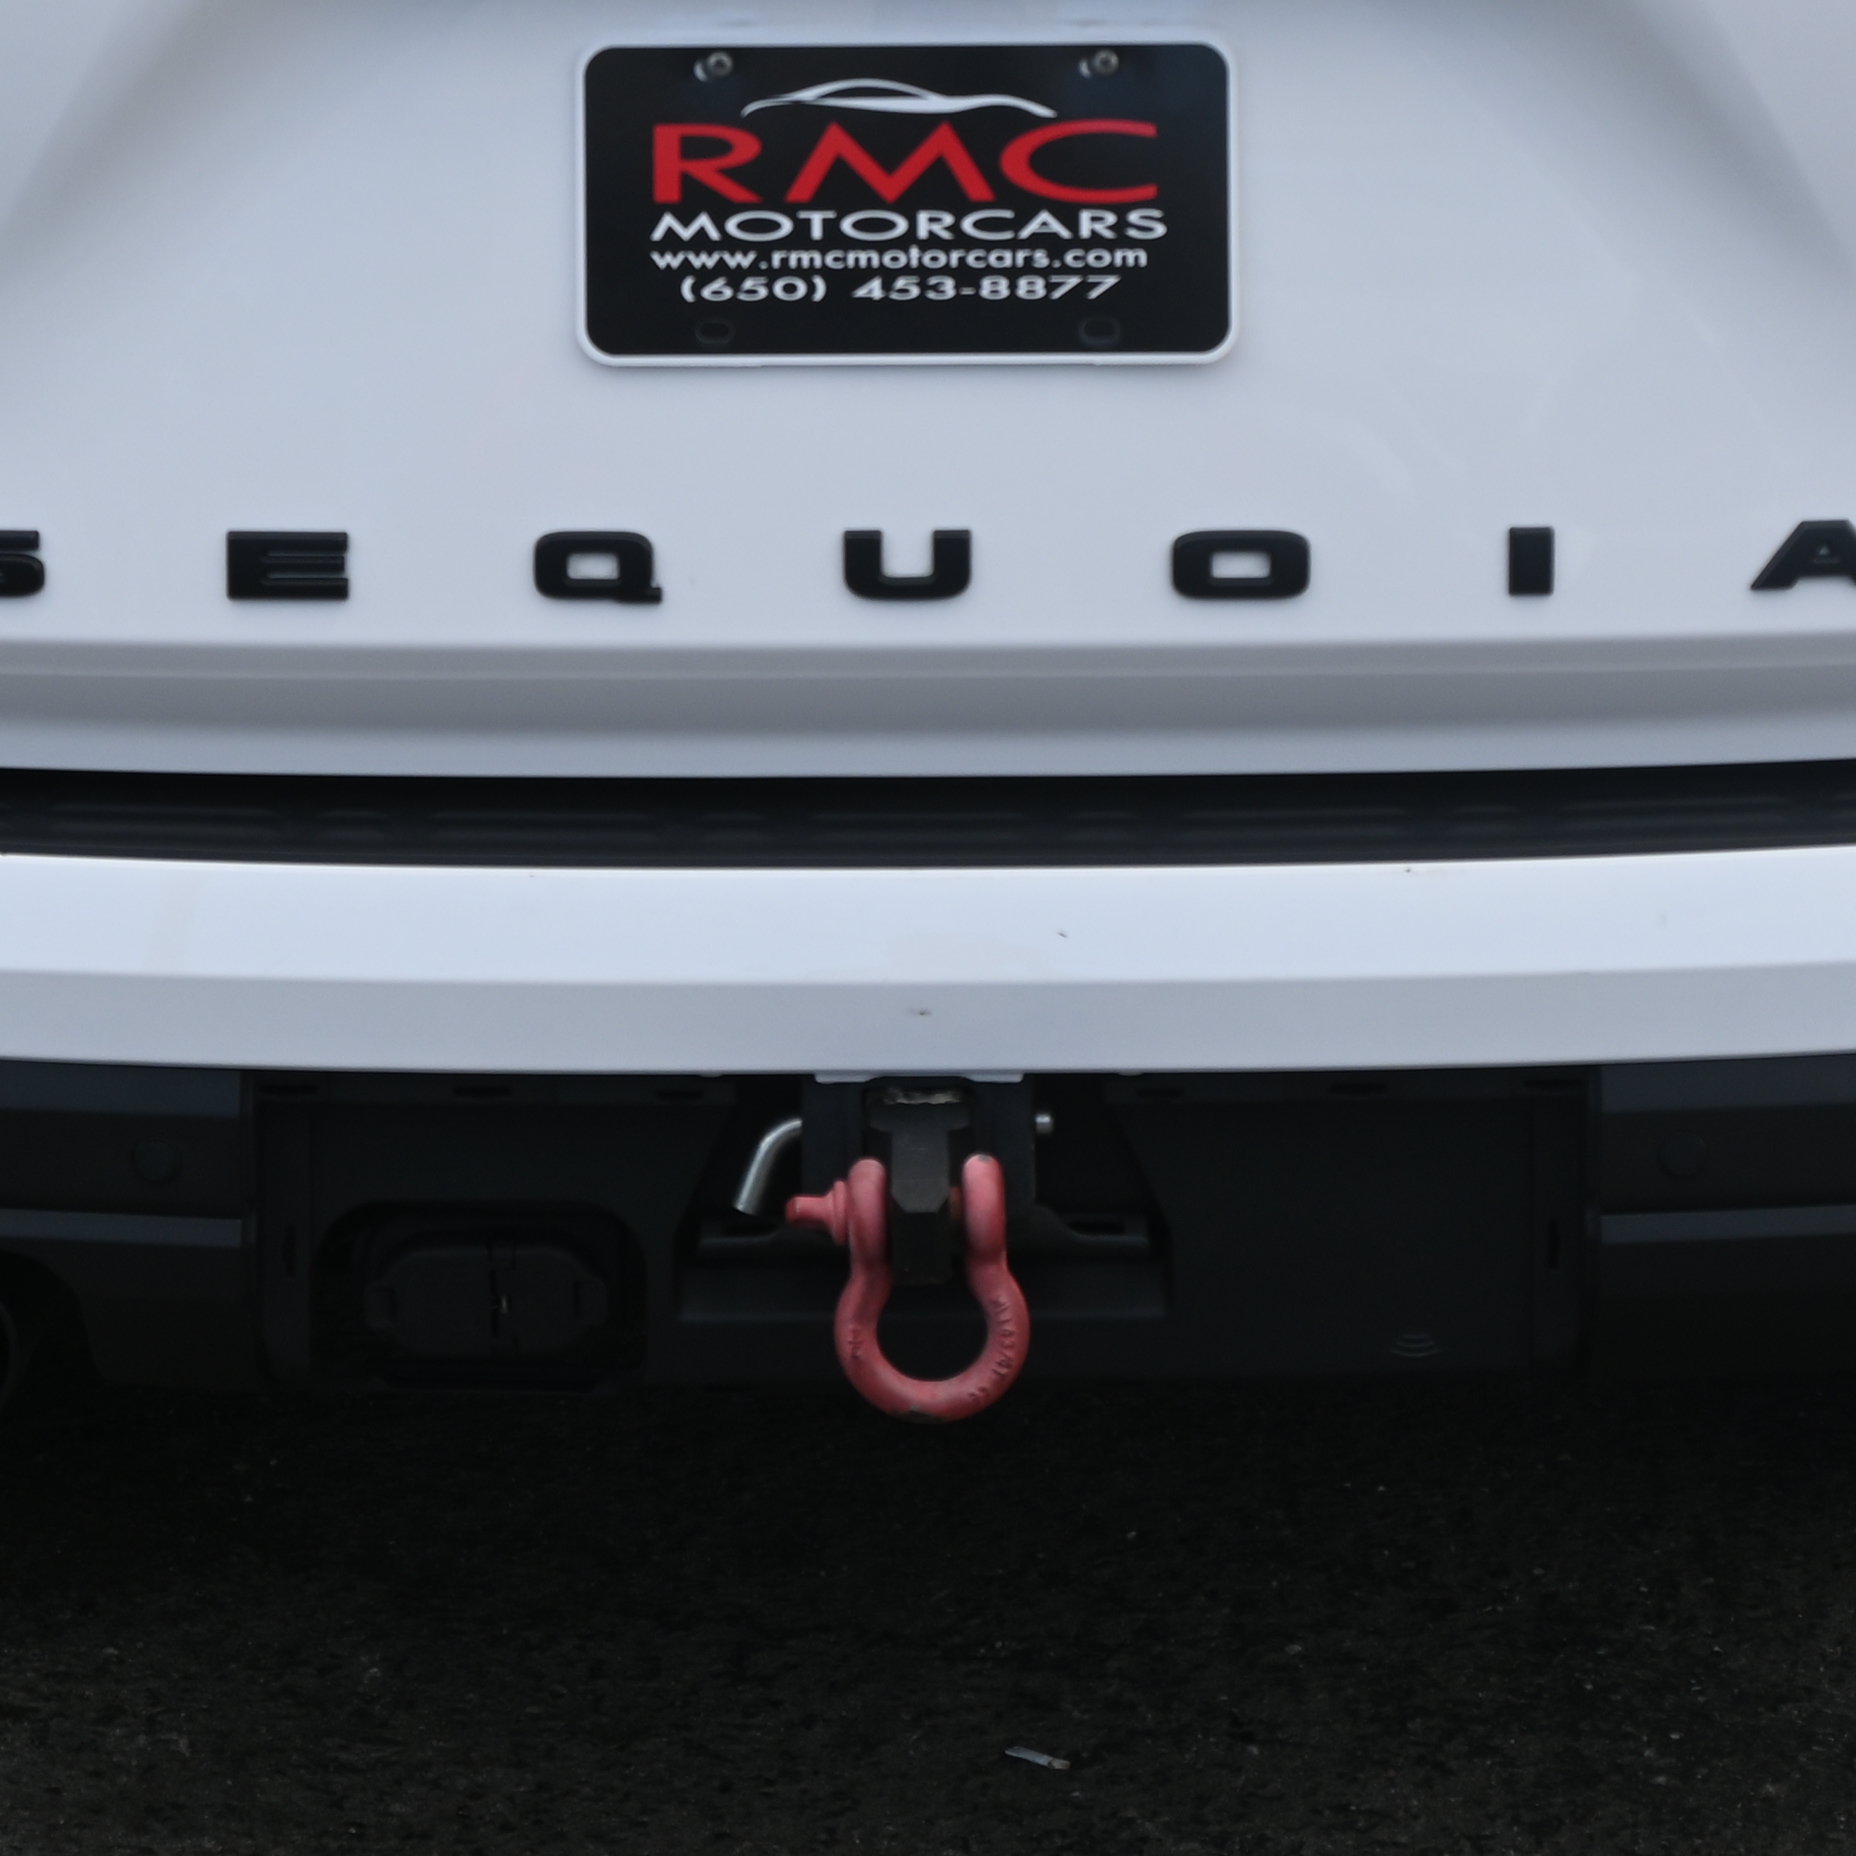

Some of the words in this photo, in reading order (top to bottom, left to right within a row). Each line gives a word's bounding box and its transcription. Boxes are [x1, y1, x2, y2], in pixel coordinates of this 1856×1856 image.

[651, 119, 1159, 204] RMC
[651, 209, 1168, 242] MOTORCARS
[650, 244, 1148, 270] www.rmcmotorcars.com
[680, 275, 828, 303] (650)
[852, 275, 1121, 302] 453-8877
